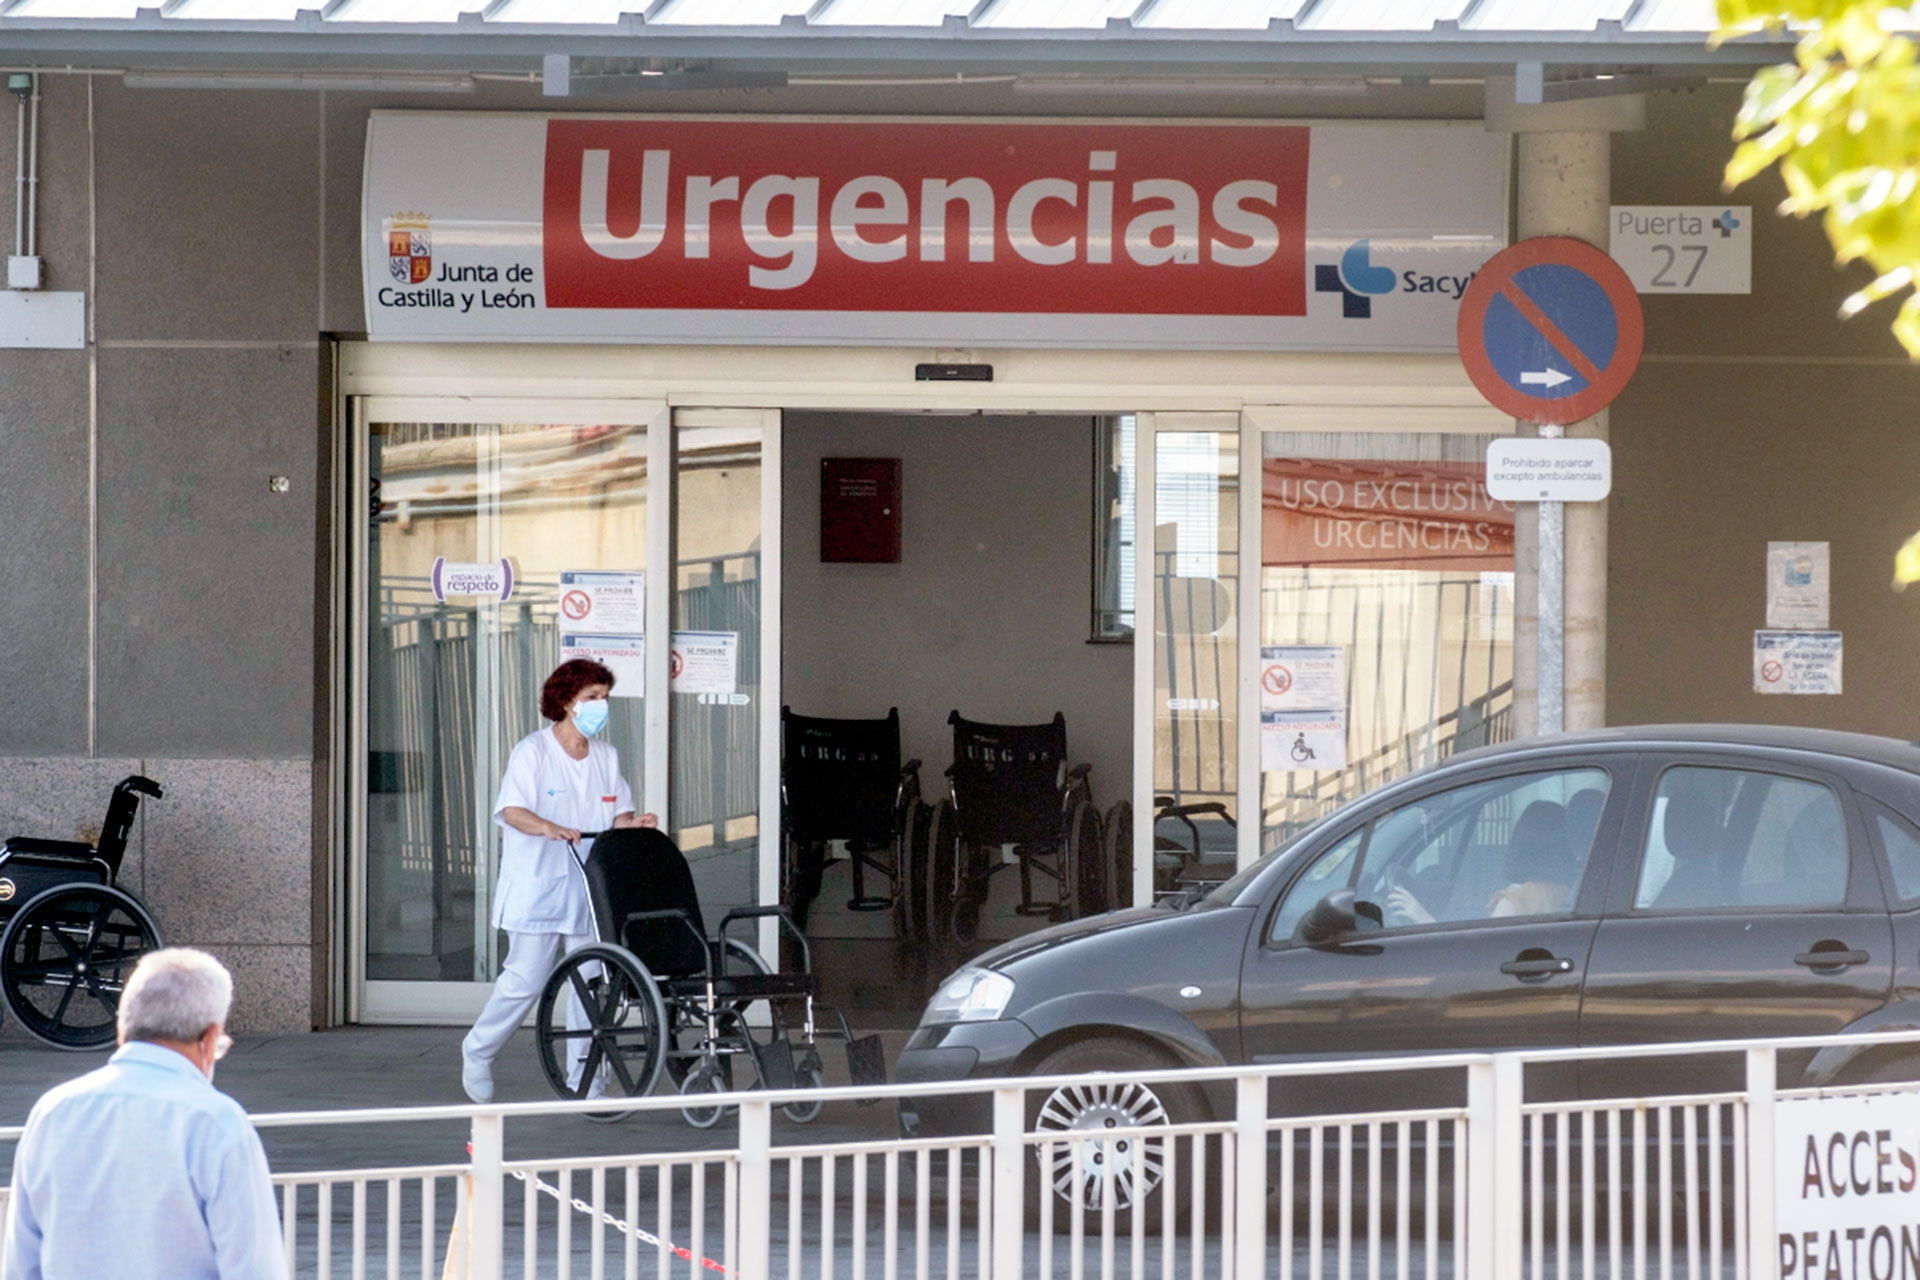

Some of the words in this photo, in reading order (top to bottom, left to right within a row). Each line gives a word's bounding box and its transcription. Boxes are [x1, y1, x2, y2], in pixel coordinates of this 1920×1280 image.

[580, 149, 1280, 290] Urgencias
[1617, 211, 1703, 235] Puerta
[436, 261, 498, 282] Junta
[505, 262, 534, 283] de
[1650, 244, 1709, 288] 27
[378, 286, 454, 308] Castilla
[461, 292, 474, 312] y
[481, 287, 536, 309] León
[1502, 457, 1552, 468] Prohibido
[1554, 459, 1594, 469] aparcar
[1493, 471, 1535, 482] excepto
[1536, 470, 1603, 481] ambulancias
[1281, 479, 1345, 508] USO
[1313, 519, 1491, 551] URGENCIAS
[447, 578, 499, 594] respeto
[450, 573, 482, 582] espacio
[483, 572, 495, 581] de
